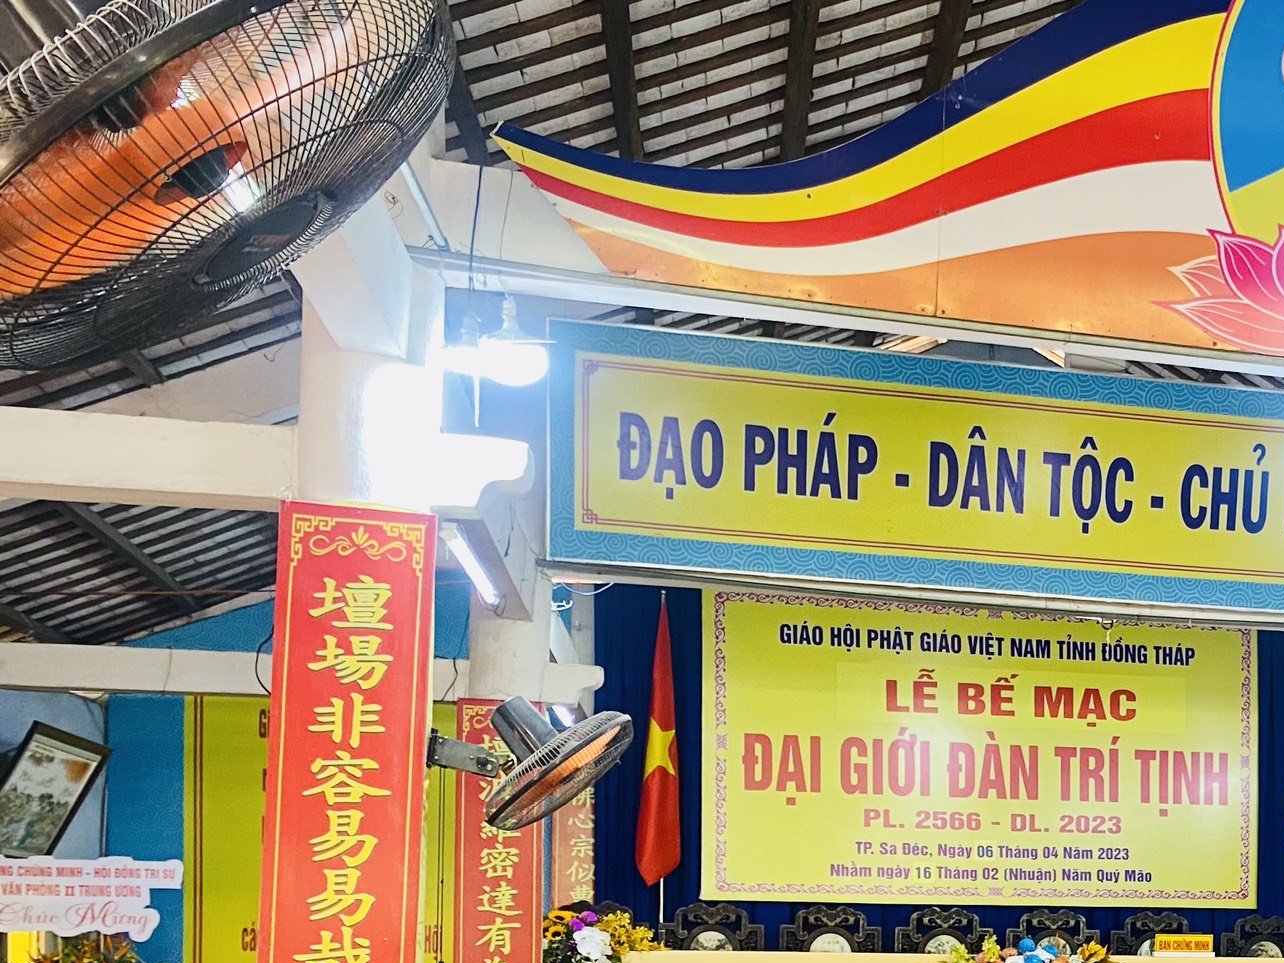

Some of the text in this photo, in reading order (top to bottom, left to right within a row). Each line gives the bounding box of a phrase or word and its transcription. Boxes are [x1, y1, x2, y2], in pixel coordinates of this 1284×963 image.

[617, 411, 724, 500] ĐẠO
[743, 413, 879, 500] PHÁP
[928, 425, 1026, 515] DÂN
[1042, 436, 1135, 534] TỘC
[1180, 443, 1270, 534] CHỦ
[779, 621, 1196, 666] GIÁO HỘI PHẬT GIÁO VIỆT NAM TỈNH ĐỒNG THÁP
[885, 668, 1137, 728] LỄ BẾ MẠC
[742, 727, 1229, 817] ĐẠI GIỚI ĐÀN TRÍ TỊNH
[863, 808, 905, 828] PL.
[915, 810, 982, 831] 2566
[1010, 813, 1050, 832] DL.
[1059, 815, 1122, 834] 2023
[830, 861, 1152, 884] Nhằm ngày 16 Tháng 02 (Nhuận) Năm Quý Mão
[855, 841, 874, 855] TP.
[880, 842, 897, 855] Sa
[938, 843, 972, 858] Ngày
[977, 845, 993, 858] 06
[998, 845, 1038, 860] Tháng
[1042, 846, 1058, 859] 04
[1063, 846, 1093, 860] Năm
[1097, 848, 1129, 860] 2023
